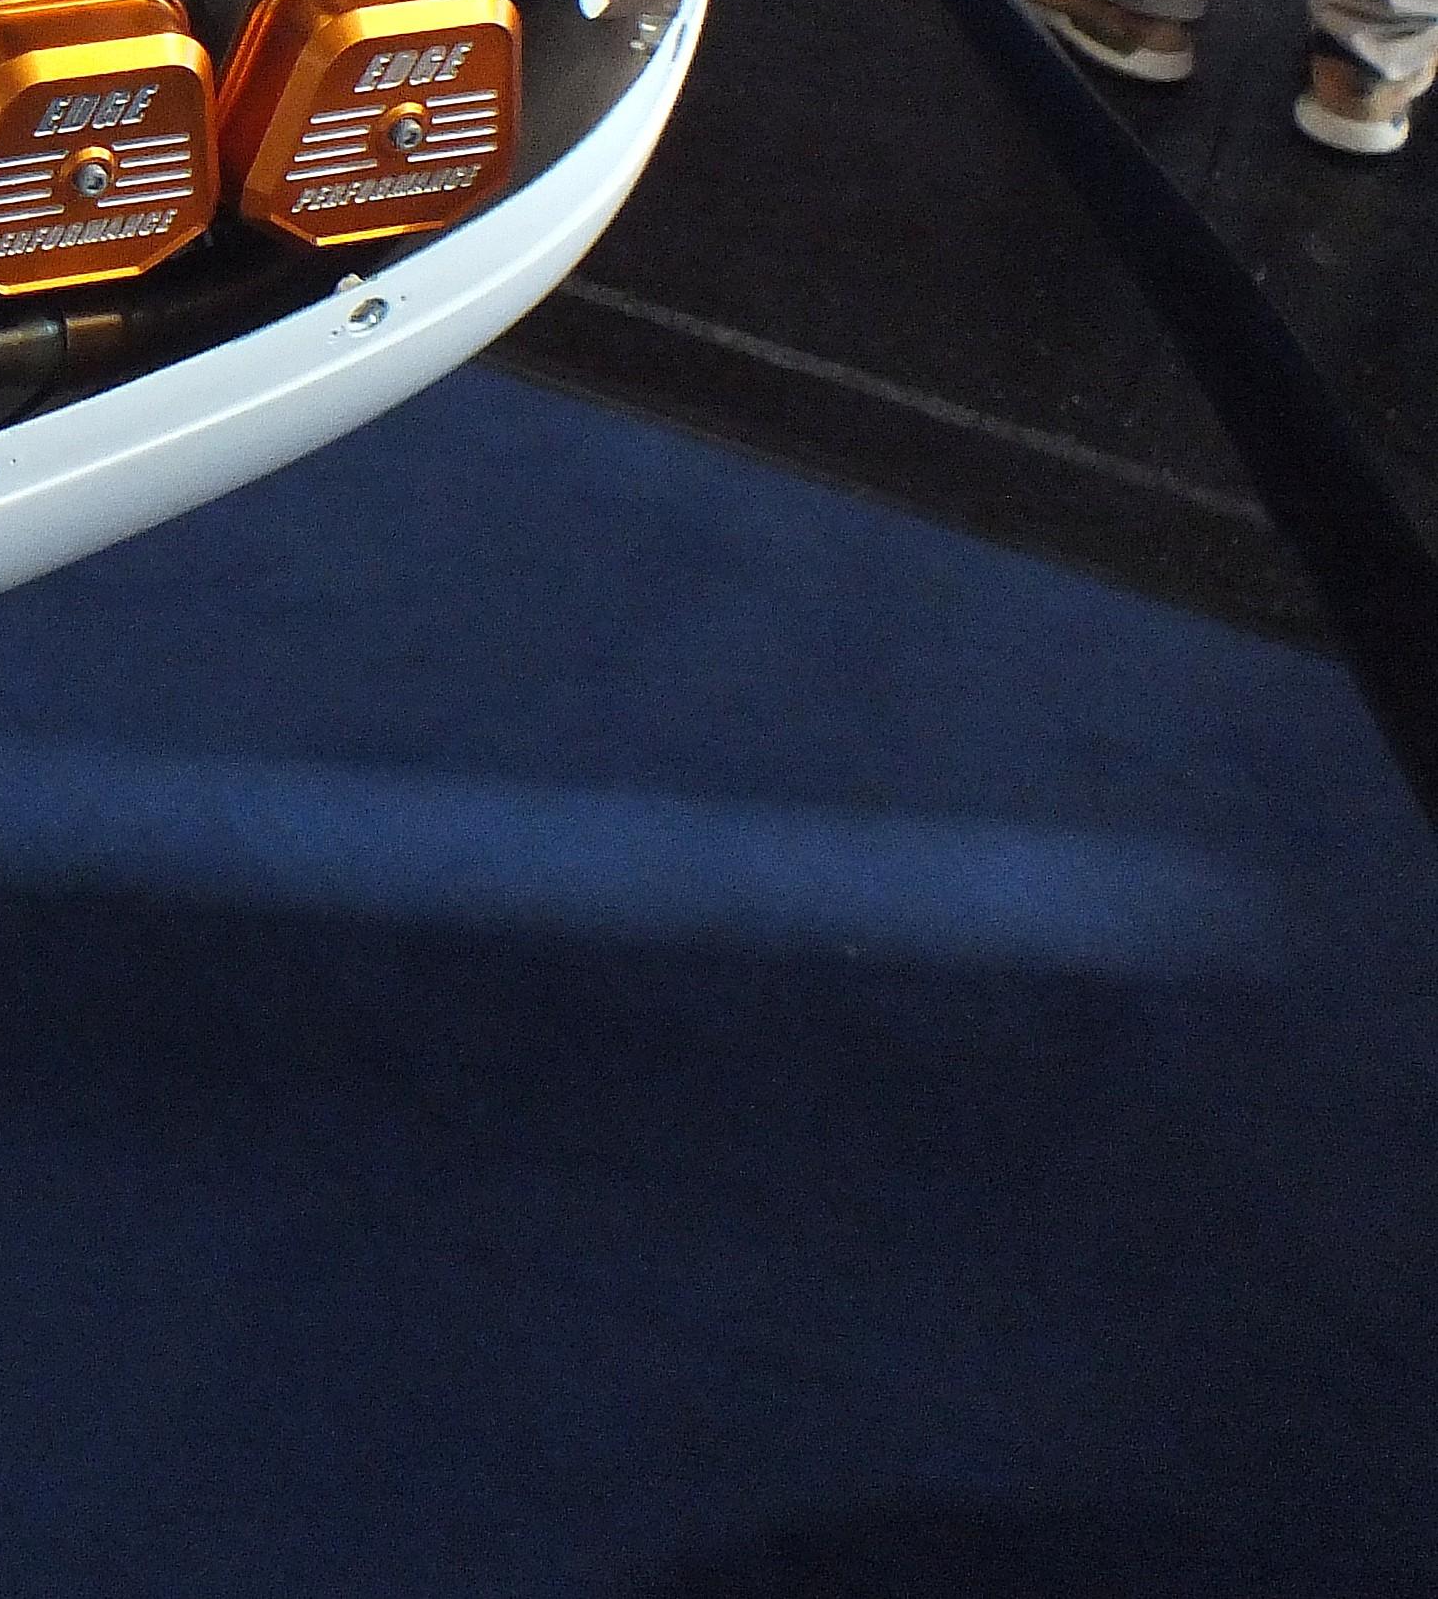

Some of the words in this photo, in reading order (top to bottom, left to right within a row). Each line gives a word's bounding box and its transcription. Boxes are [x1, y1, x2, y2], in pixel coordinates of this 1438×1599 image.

[353, 42, 474, 94] EDGE
[33, 84, 160, 138] EDGE
[290, 163, 482, 214] PERFORMANCE
